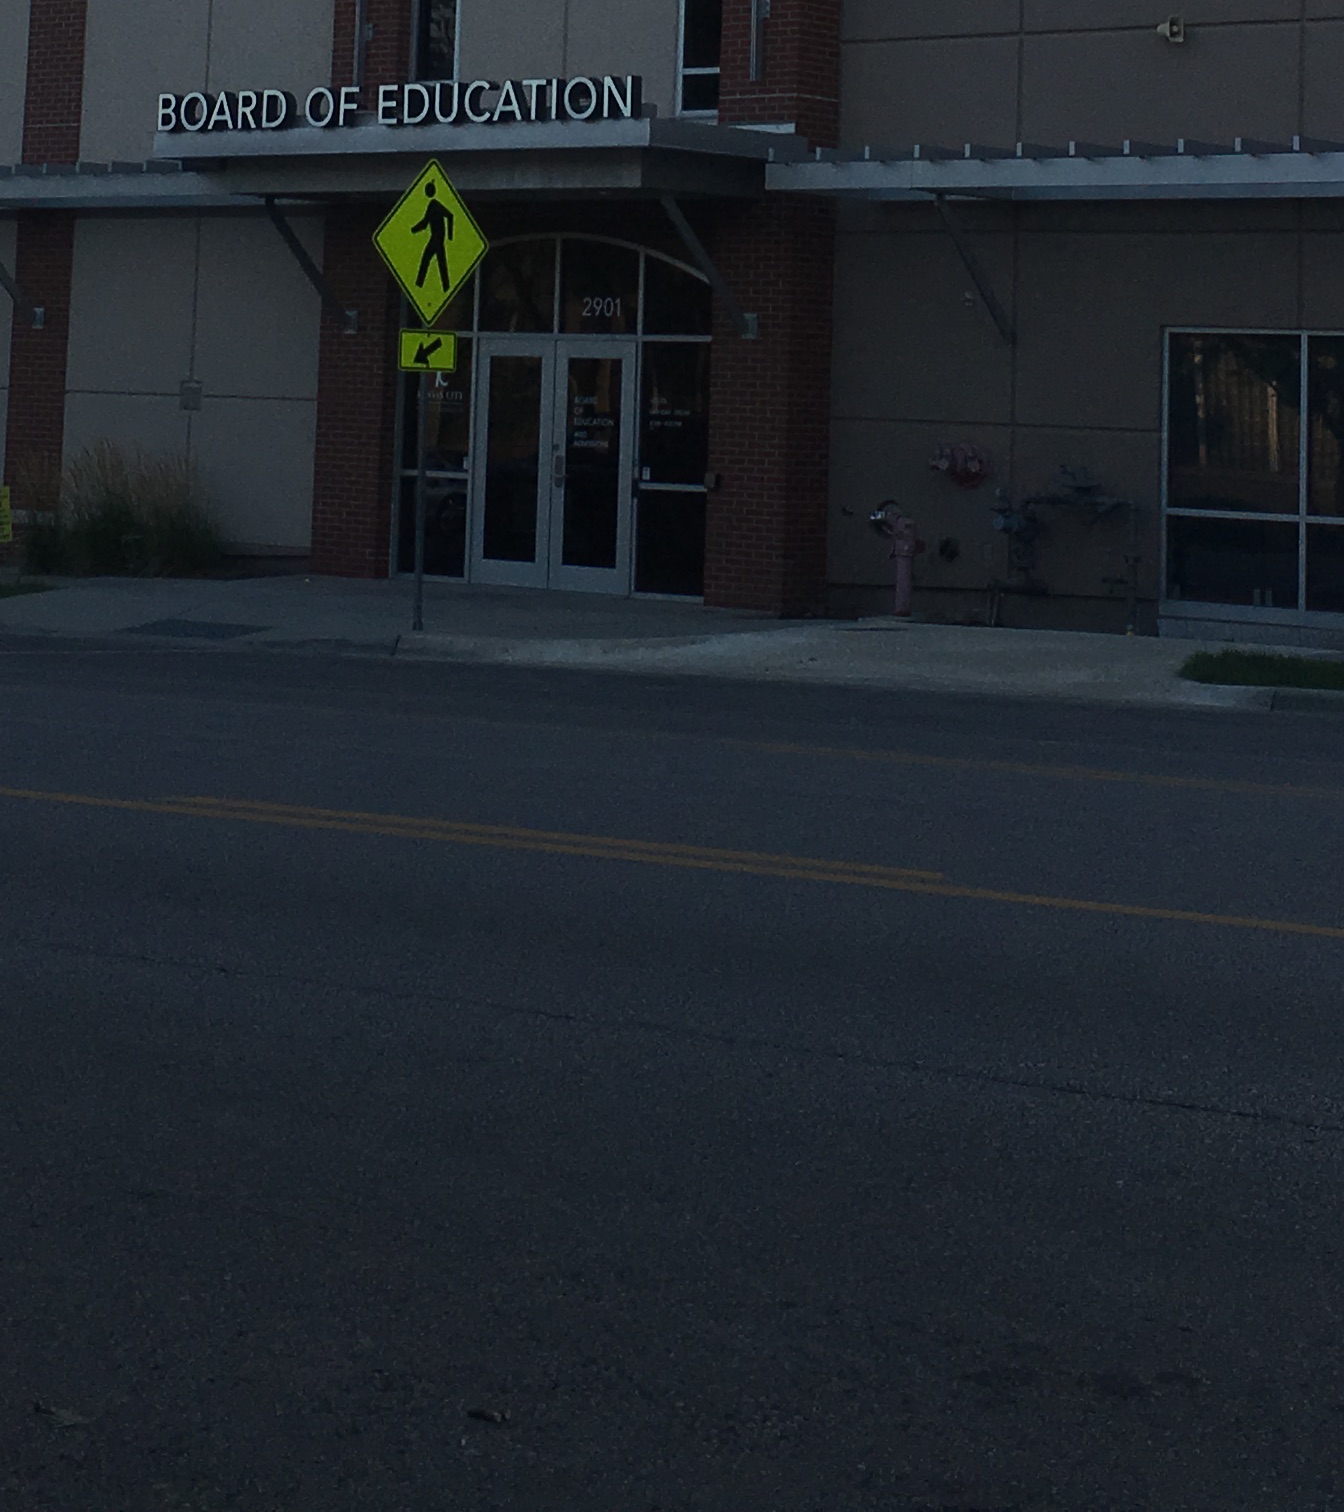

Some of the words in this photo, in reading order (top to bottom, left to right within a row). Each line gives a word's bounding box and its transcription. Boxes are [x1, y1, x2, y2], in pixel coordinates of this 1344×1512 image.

[157, 89, 288, 131] BOARD
[304, 86, 360, 128] OF
[377, 75, 634, 126] EDUCATION
[582, 297, 621, 317] 2901
[574, 417, 615, 427] EDUCATION
